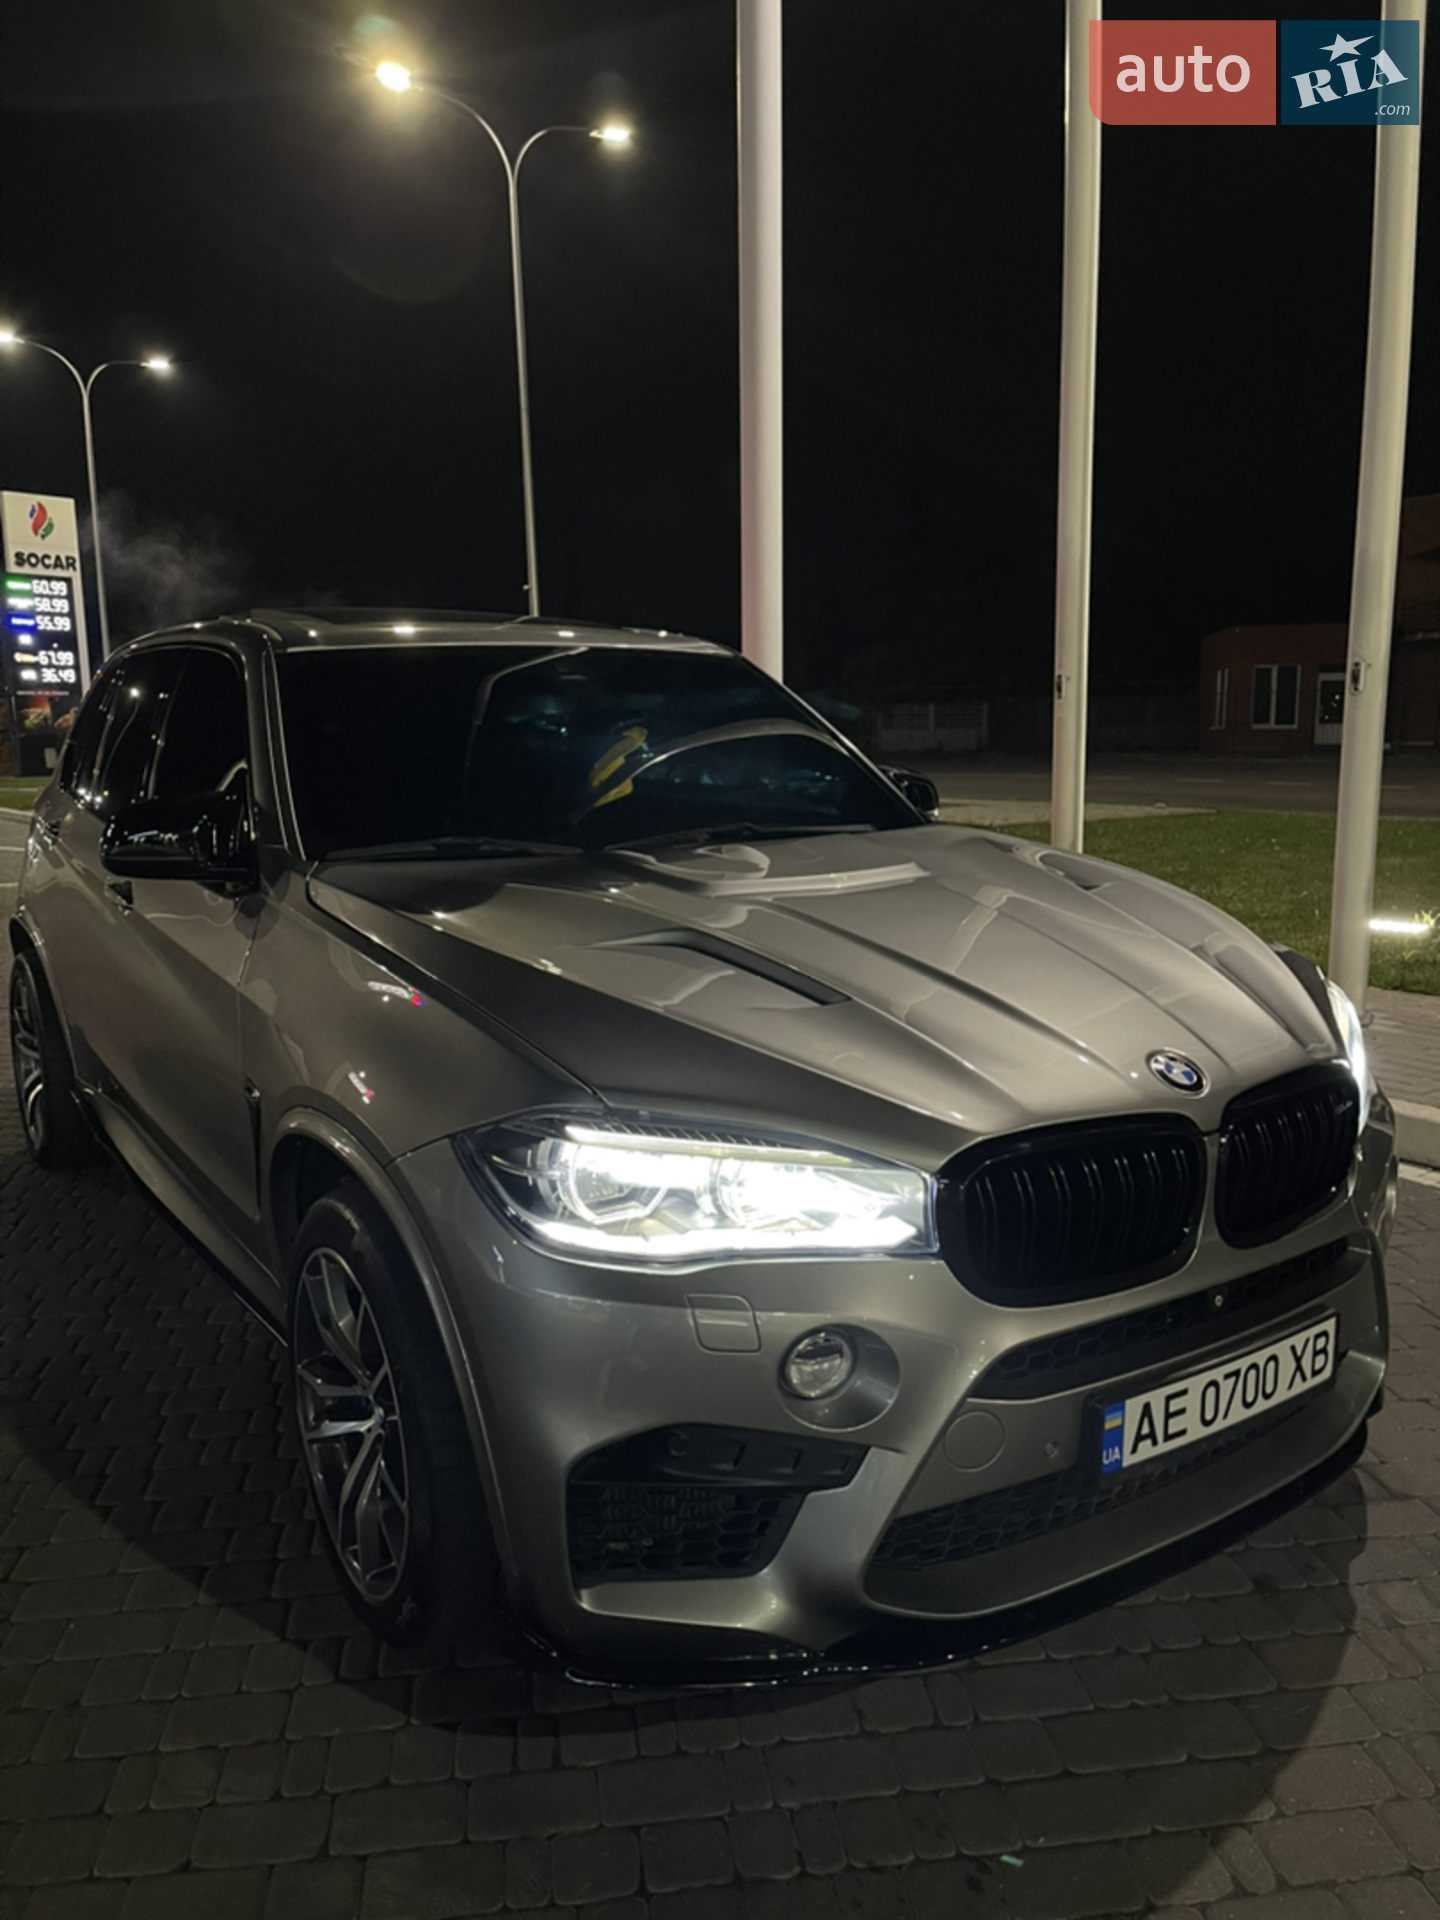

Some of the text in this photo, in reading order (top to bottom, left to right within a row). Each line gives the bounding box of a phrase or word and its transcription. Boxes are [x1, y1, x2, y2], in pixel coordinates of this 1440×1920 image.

[14, 552, 77, 571] SOCAR
[32, 579, 67, 596] 60.99
[36, 615, 71, 631] 55.99
[1130, 1329, 1330, 1455] AE 0700 XB
[1102, 1446, 1121, 1465] UA
